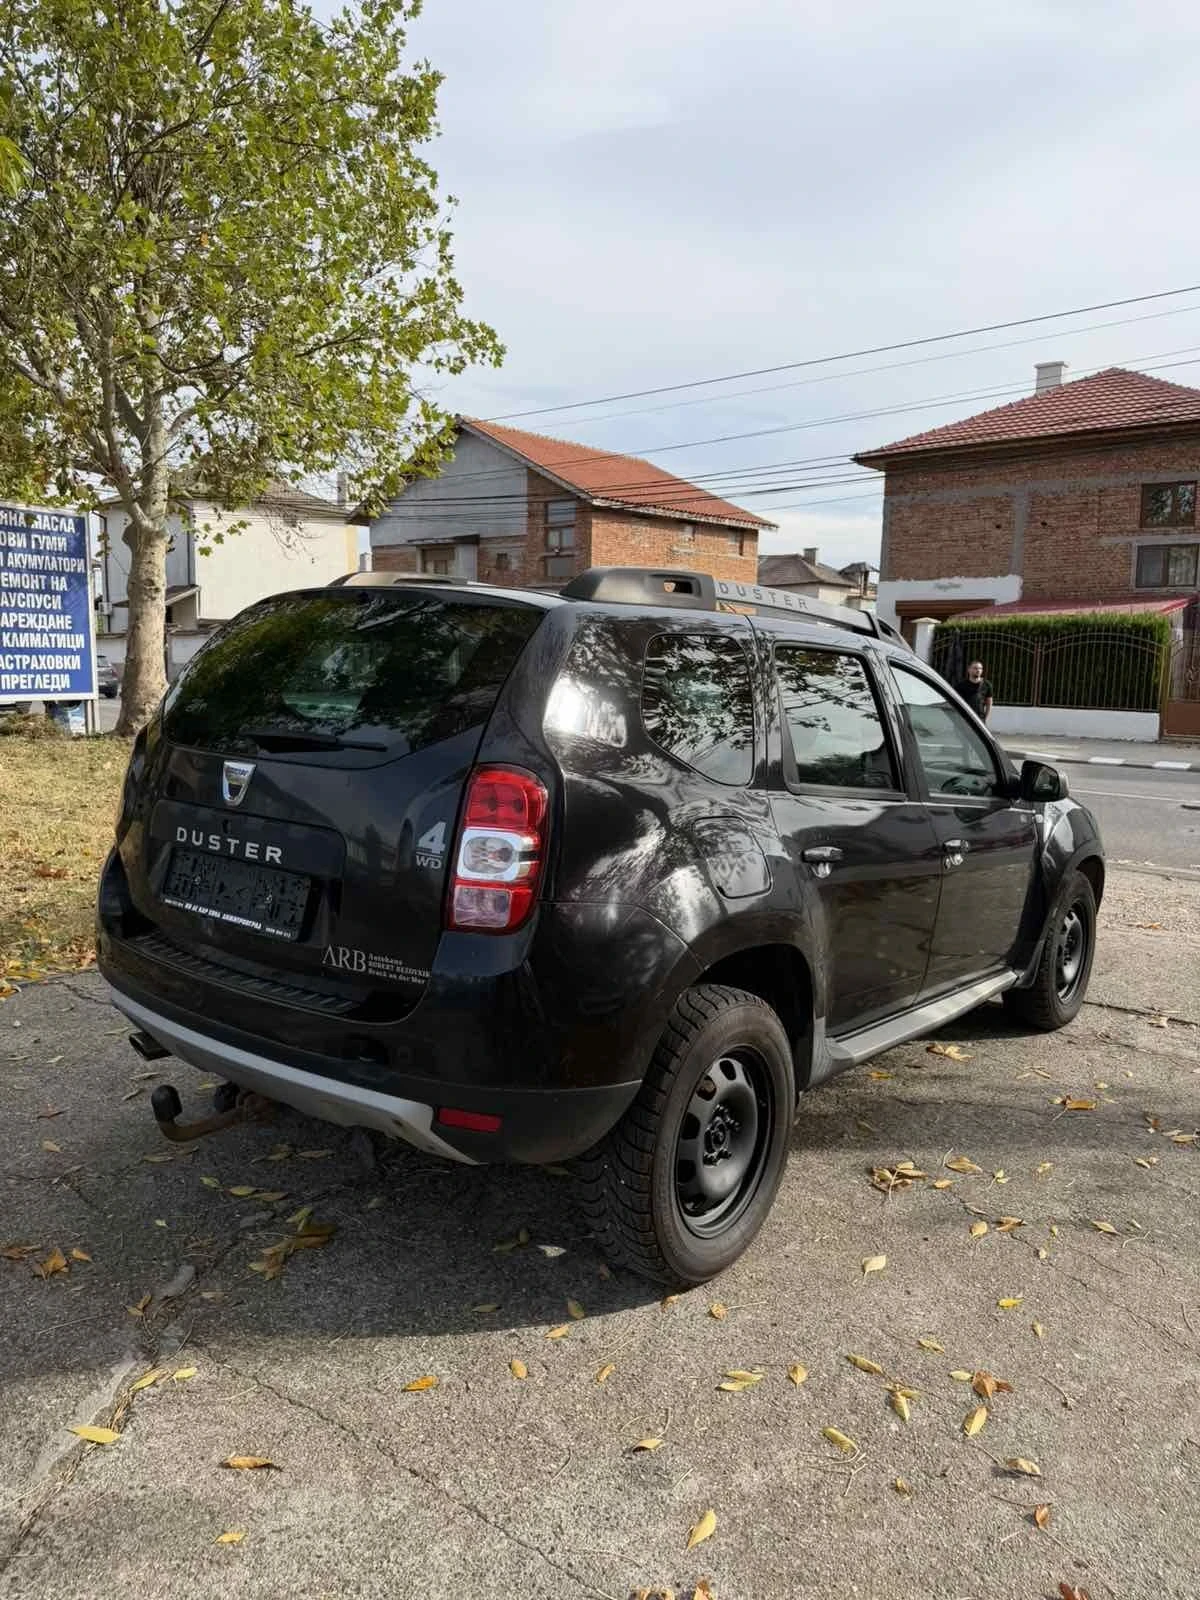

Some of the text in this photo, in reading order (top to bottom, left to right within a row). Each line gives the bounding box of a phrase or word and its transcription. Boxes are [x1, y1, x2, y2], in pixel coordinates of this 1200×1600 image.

[31, 534, 67, 552] ГУМИ
[7, 552, 85, 573] АКУМУЛАТОРИ
[1, 572, 68, 591] ЕМОНТ НА
[0, 591, 62, 610] АУСПУСИ
[718, 581, 809, 609] DUSTER
[1, 612, 72, 632] АРЕЖДАНЕ
[2, 632, 85, 652] КЛИМАТИЦИ
[1, 674, 70, 691] ПРЕГЛЕДИ
[176, 826, 282, 865] DUSTER
[322, 943, 367, 973] ARB
